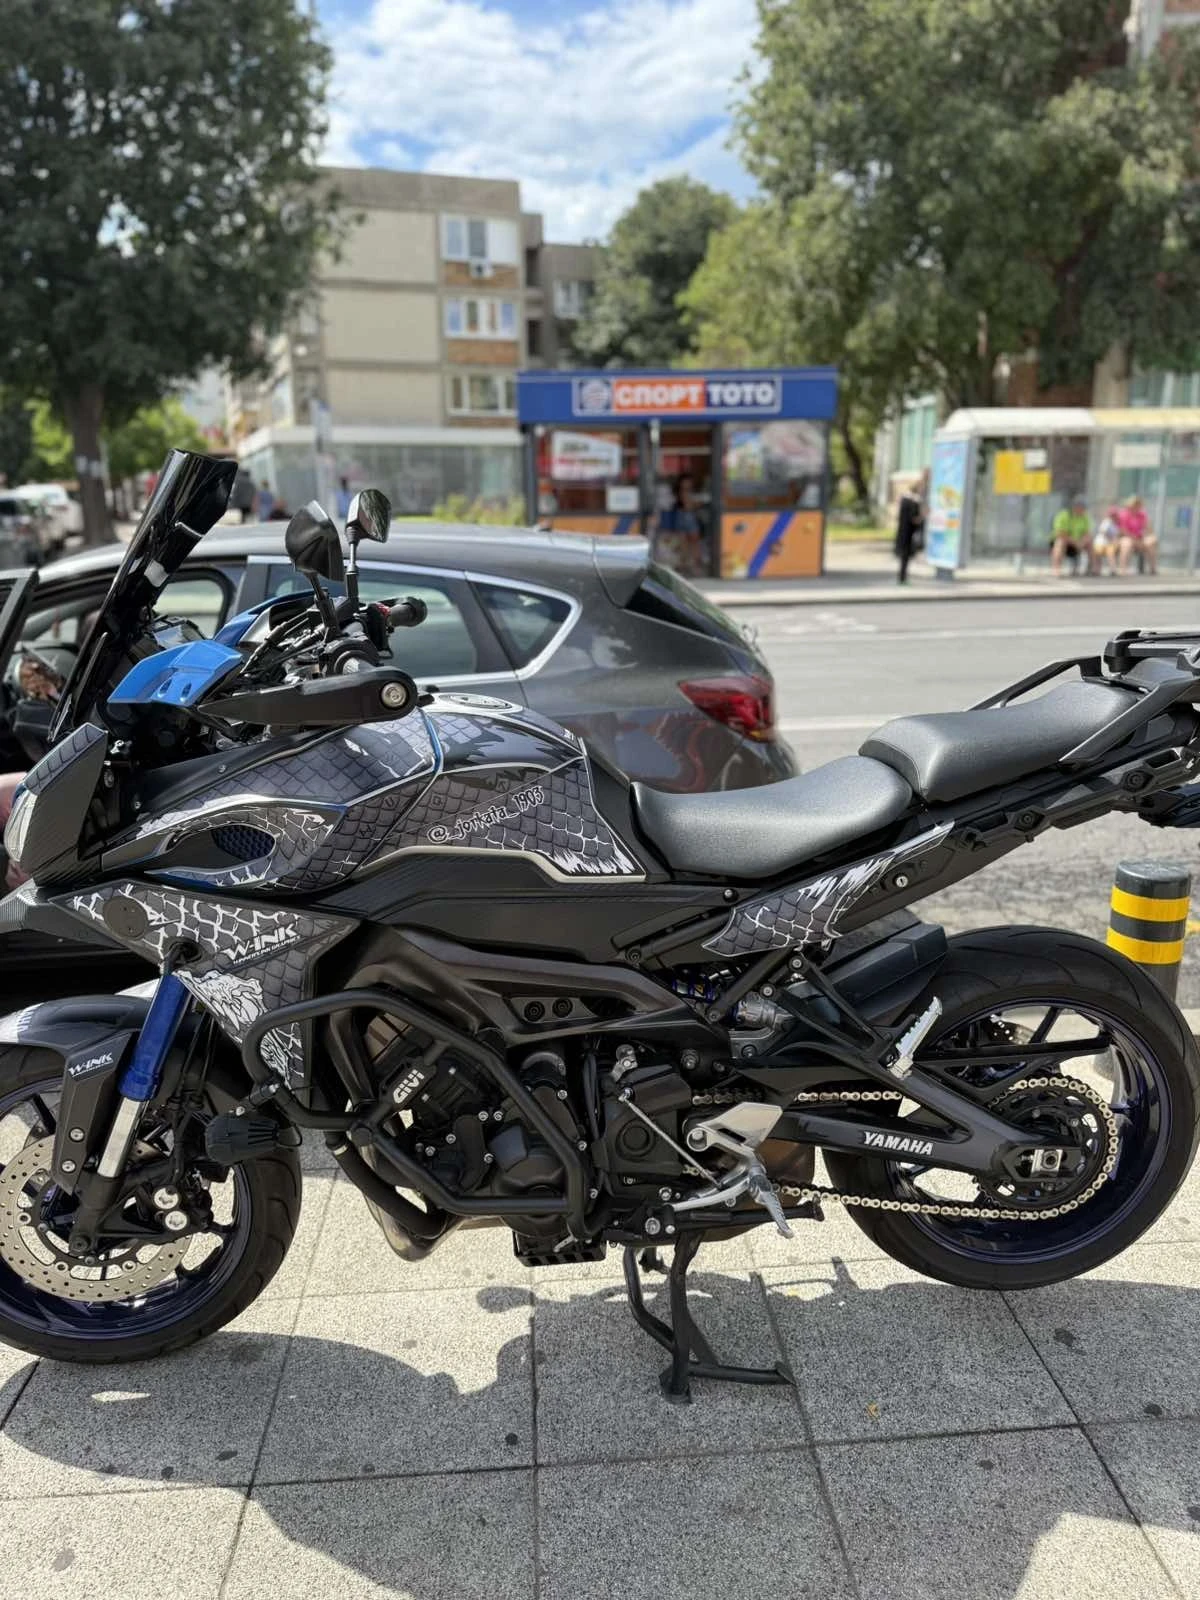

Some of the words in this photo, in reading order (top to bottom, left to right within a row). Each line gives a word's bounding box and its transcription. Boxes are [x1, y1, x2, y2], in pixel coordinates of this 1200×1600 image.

[615, 383, 703, 407] СПОРТ
[708, 381, 775, 406] ТОТО
[393, 1069, 425, 1104] GIVI
[864, 1131, 934, 1156] YAMAHA
